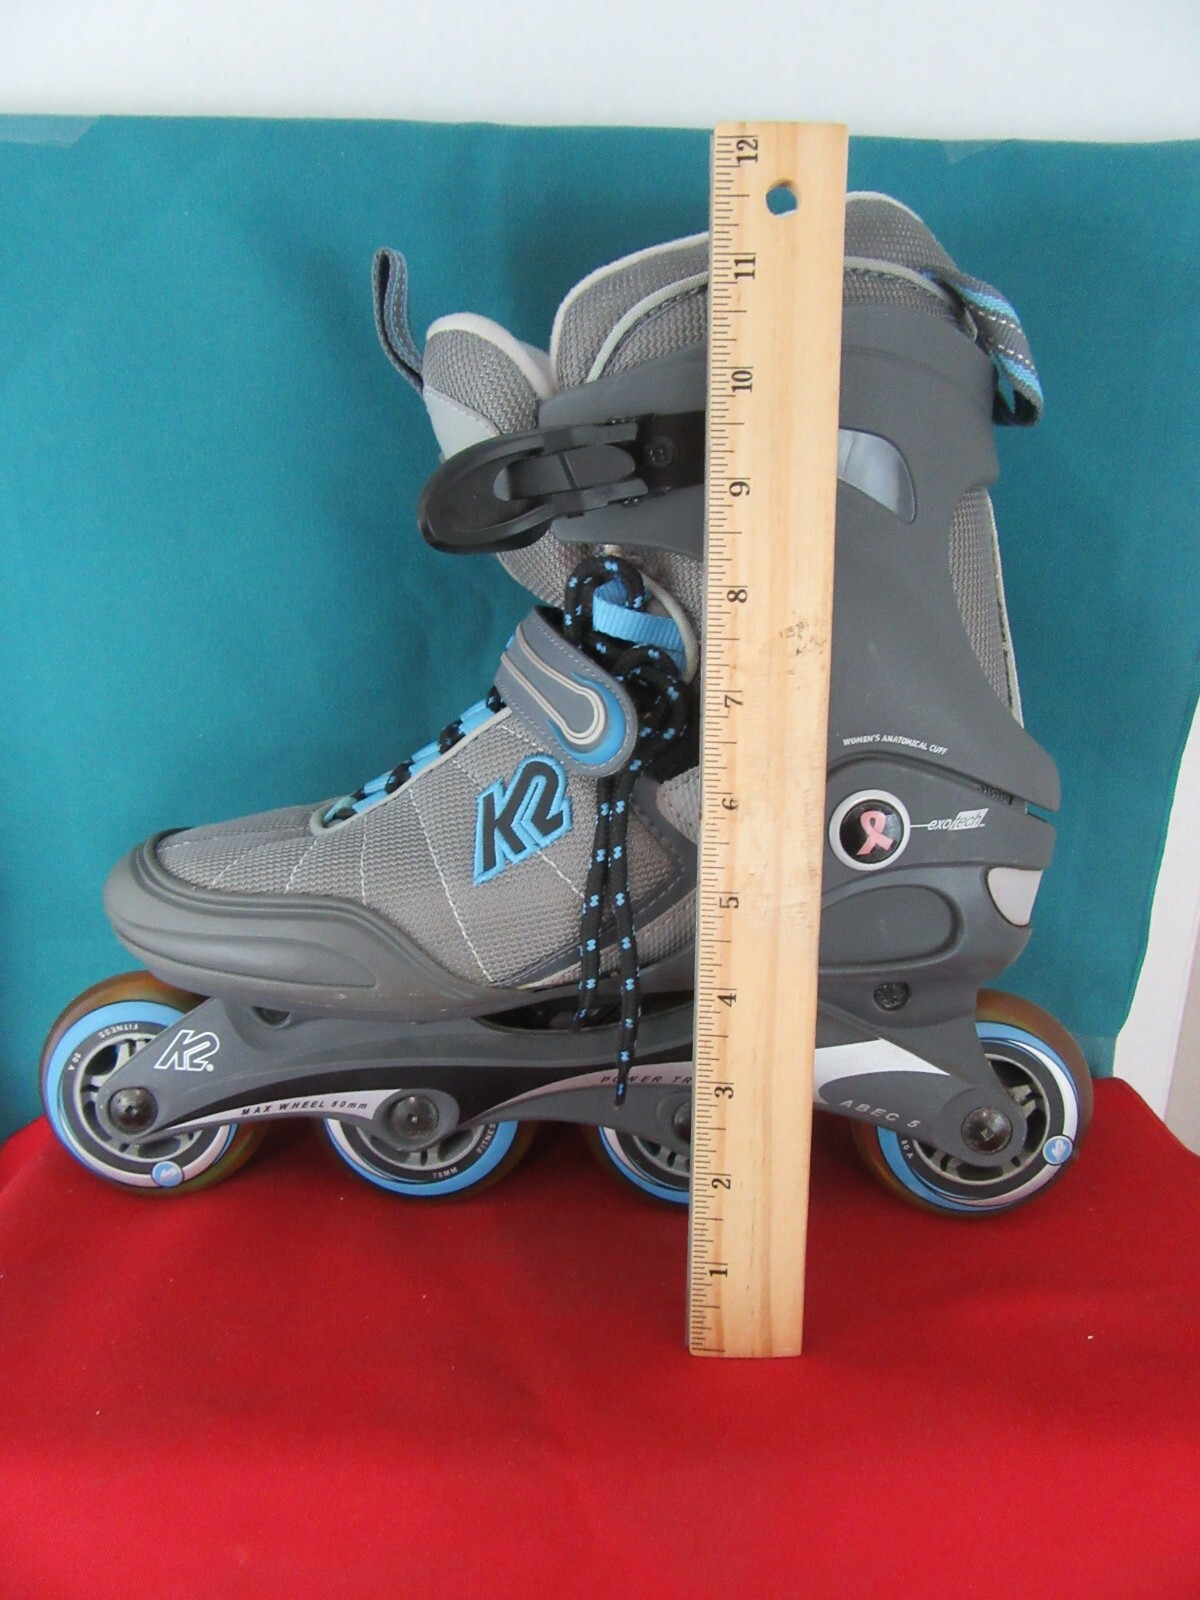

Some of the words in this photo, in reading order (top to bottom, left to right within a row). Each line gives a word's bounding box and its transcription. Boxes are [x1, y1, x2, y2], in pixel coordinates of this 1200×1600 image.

[736, 138, 758, 164] 12
[733, 254, 756, 279] 11
[731, 369, 753, 393] 10
[728, 480, 750, 497] 9
[726, 588, 748, 603] 8
[724, 694, 743, 709] 7
[842, 733, 881, 746] WOMEN'S
[881, 734, 928, 750] ANATOMICAL
[928, 744, 948, 755] CUFF
[721, 797, 738, 811] 6
[473, 752, 573, 886] K2
[719, 895, 739, 910] 5
[717, 993, 737, 1007] 4
[98, 1023, 138, 1039] FITNESS
[714, 1086, 734, 1099] 3
[241, 1105, 272, 1116] MAX
[279, 1101, 325, 1111] WHEEL
[839, 1099, 900, 1122] ABEC
[907, 1119, 921, 1129] 5
[711, 1177, 731, 1190] 2
[708, 1265, 728, 1278] 1
